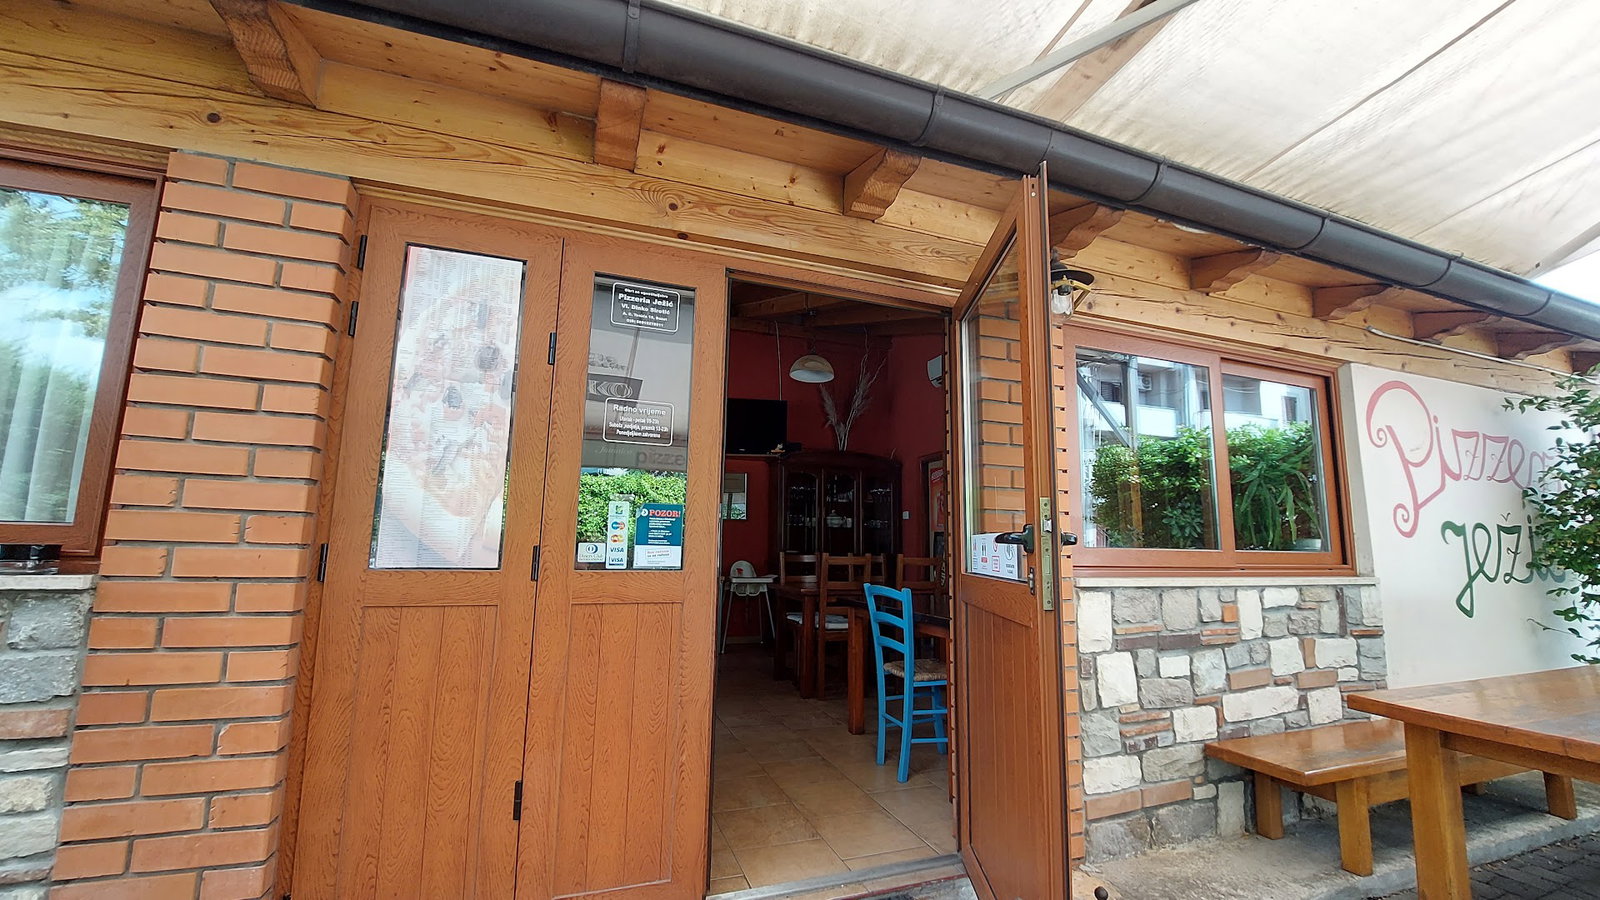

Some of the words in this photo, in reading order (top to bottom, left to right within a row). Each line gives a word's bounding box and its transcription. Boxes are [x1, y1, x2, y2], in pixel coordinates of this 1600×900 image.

[618, 293, 650, 304] Pizzeria
[653, 298, 674, 307] Ježić
[613, 404, 638, 413] Radno
[639, 406, 666, 416] vrijeme
